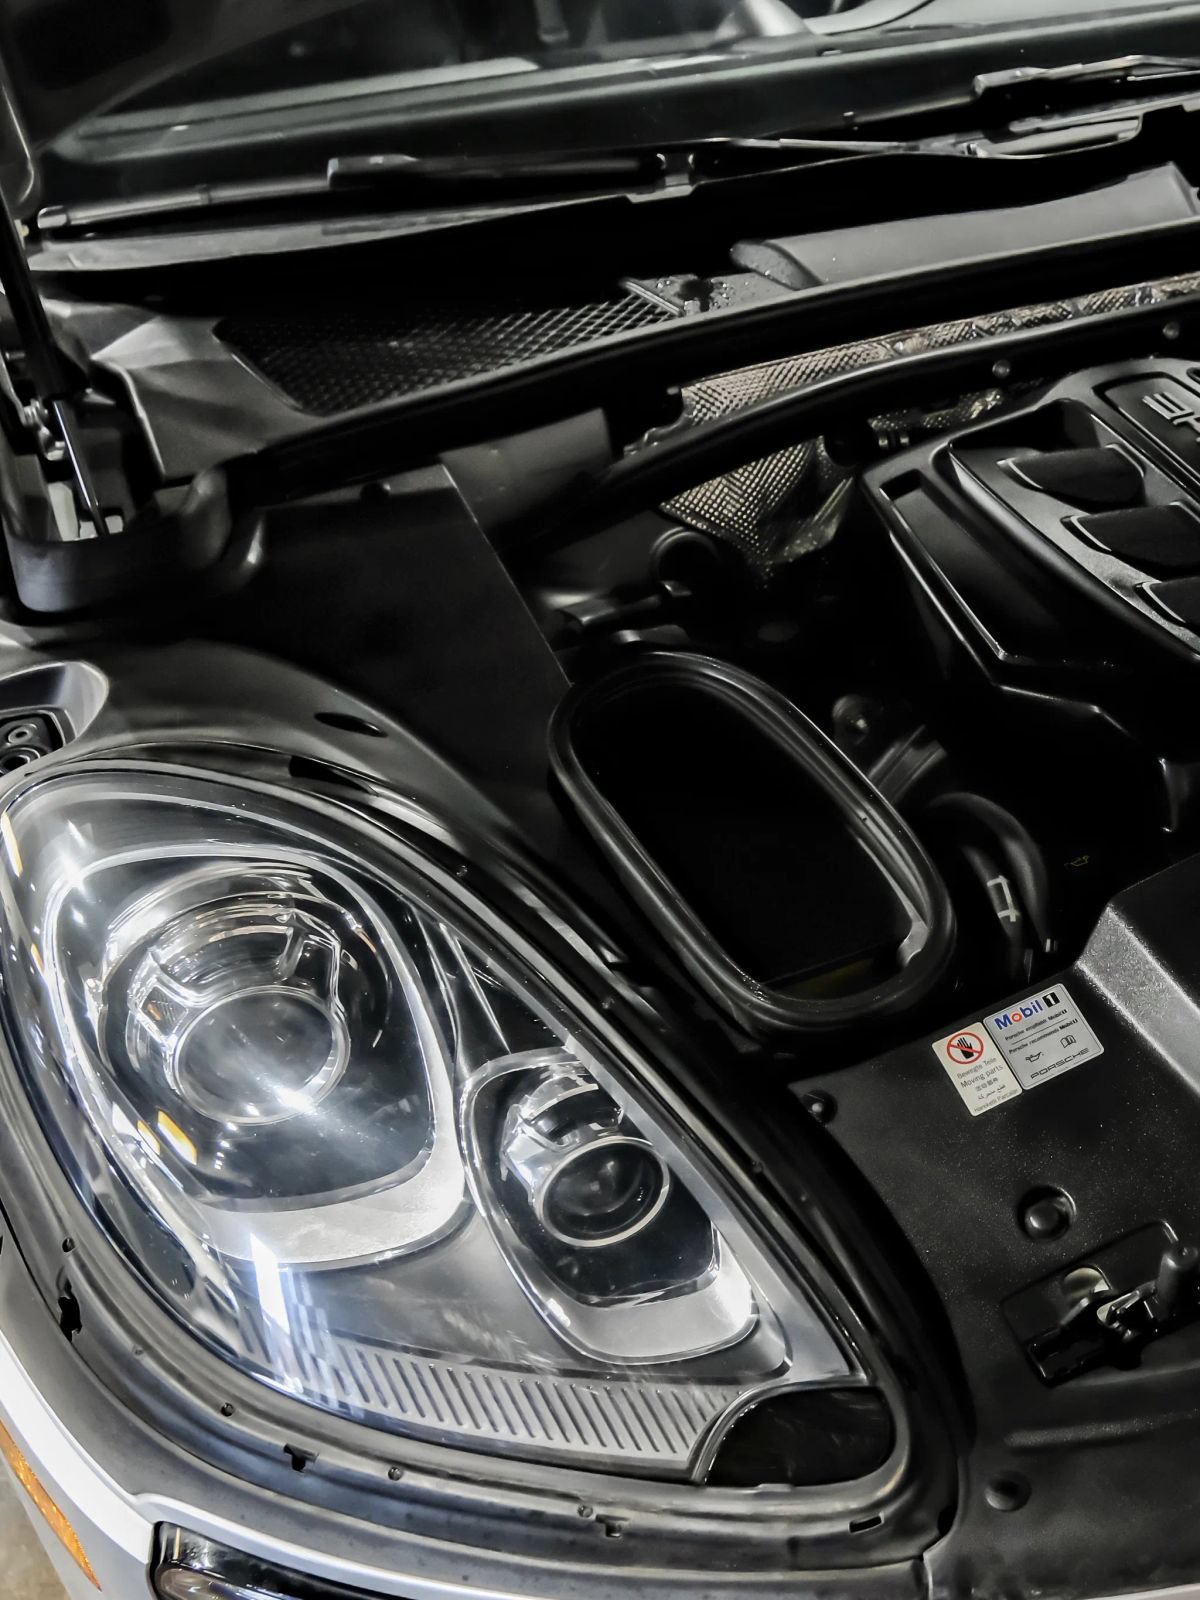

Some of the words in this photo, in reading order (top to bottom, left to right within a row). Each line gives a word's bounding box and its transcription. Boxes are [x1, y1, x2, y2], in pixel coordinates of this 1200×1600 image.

[994, 1000, 1043, 1030] Mobil
[1043, 993, 1058, 1007] 1
[960, 1073, 985, 1088] Moving
[985, 1065, 1003, 1078] parts
[1030, 1048, 1089, 1079] PORSCHE
